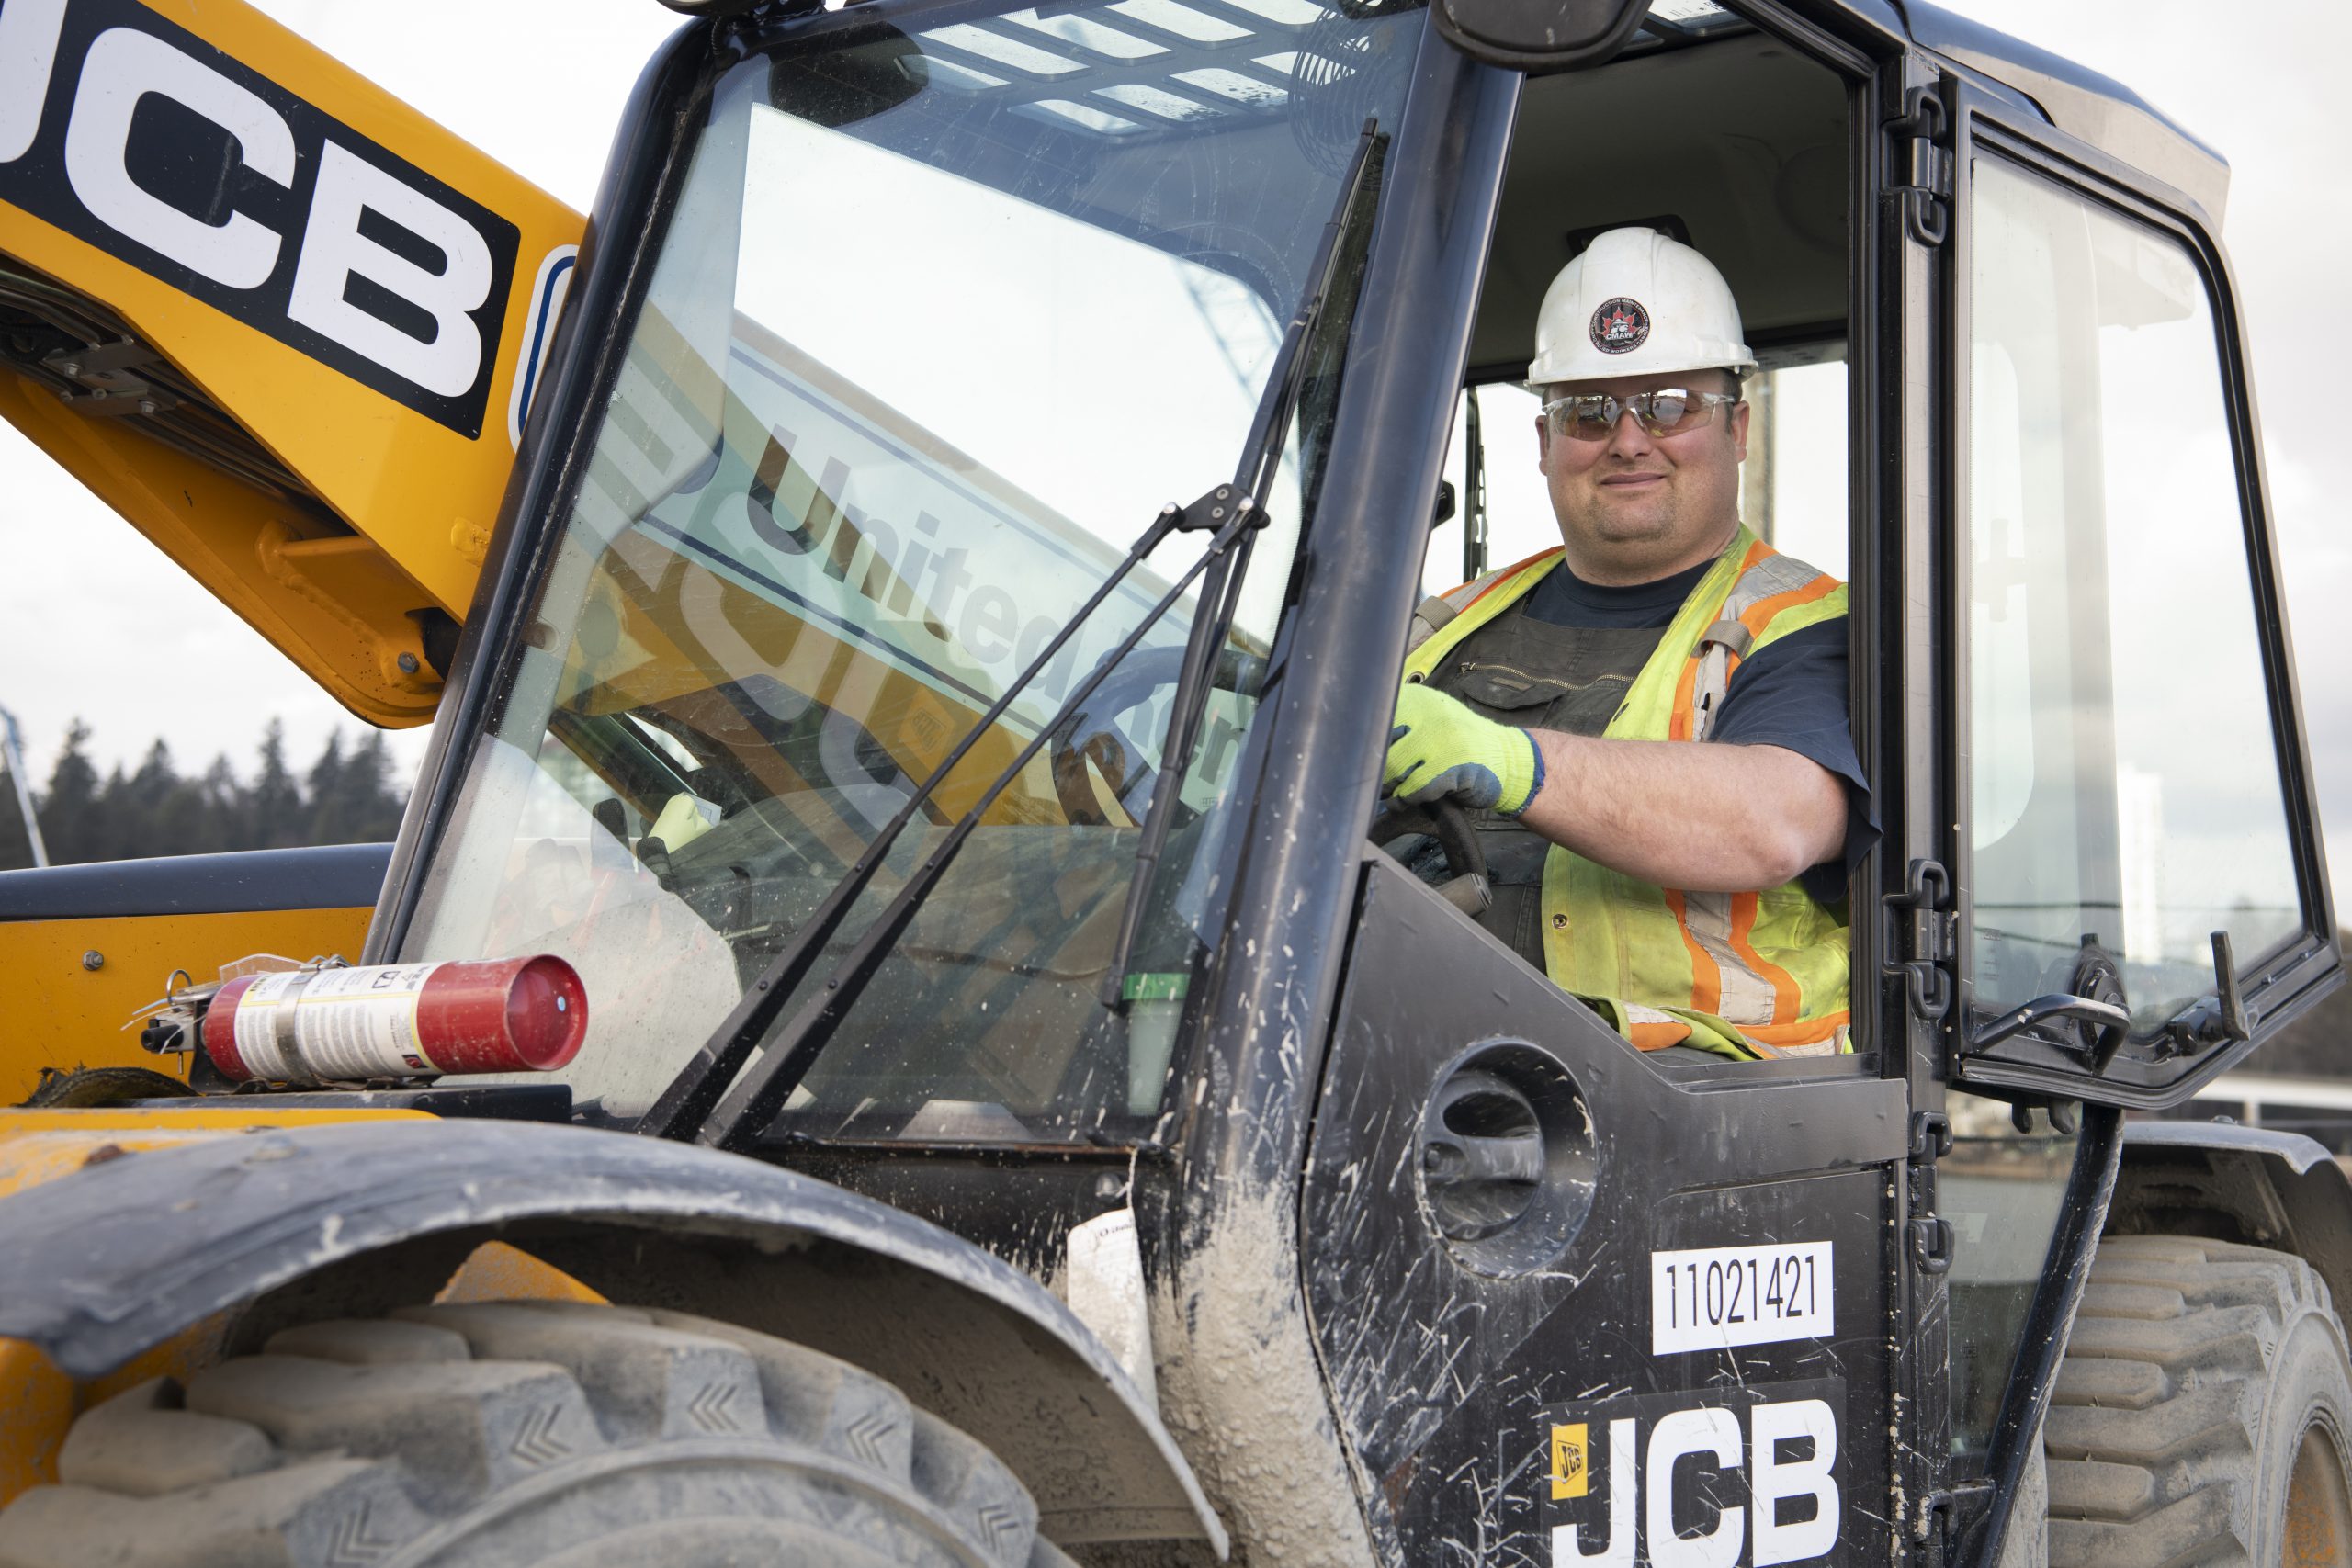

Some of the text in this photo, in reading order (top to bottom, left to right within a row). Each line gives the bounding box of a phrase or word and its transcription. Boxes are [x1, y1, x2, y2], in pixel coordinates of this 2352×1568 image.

[1606, 332, 1634, 340] CMAW
[746, 423, 1090, 704] United
[1666, 1255, 1815, 1329] 11021421
[1552, 1399, 1840, 1568] JCB
[1561, 1445, 1582, 1479] JCB
